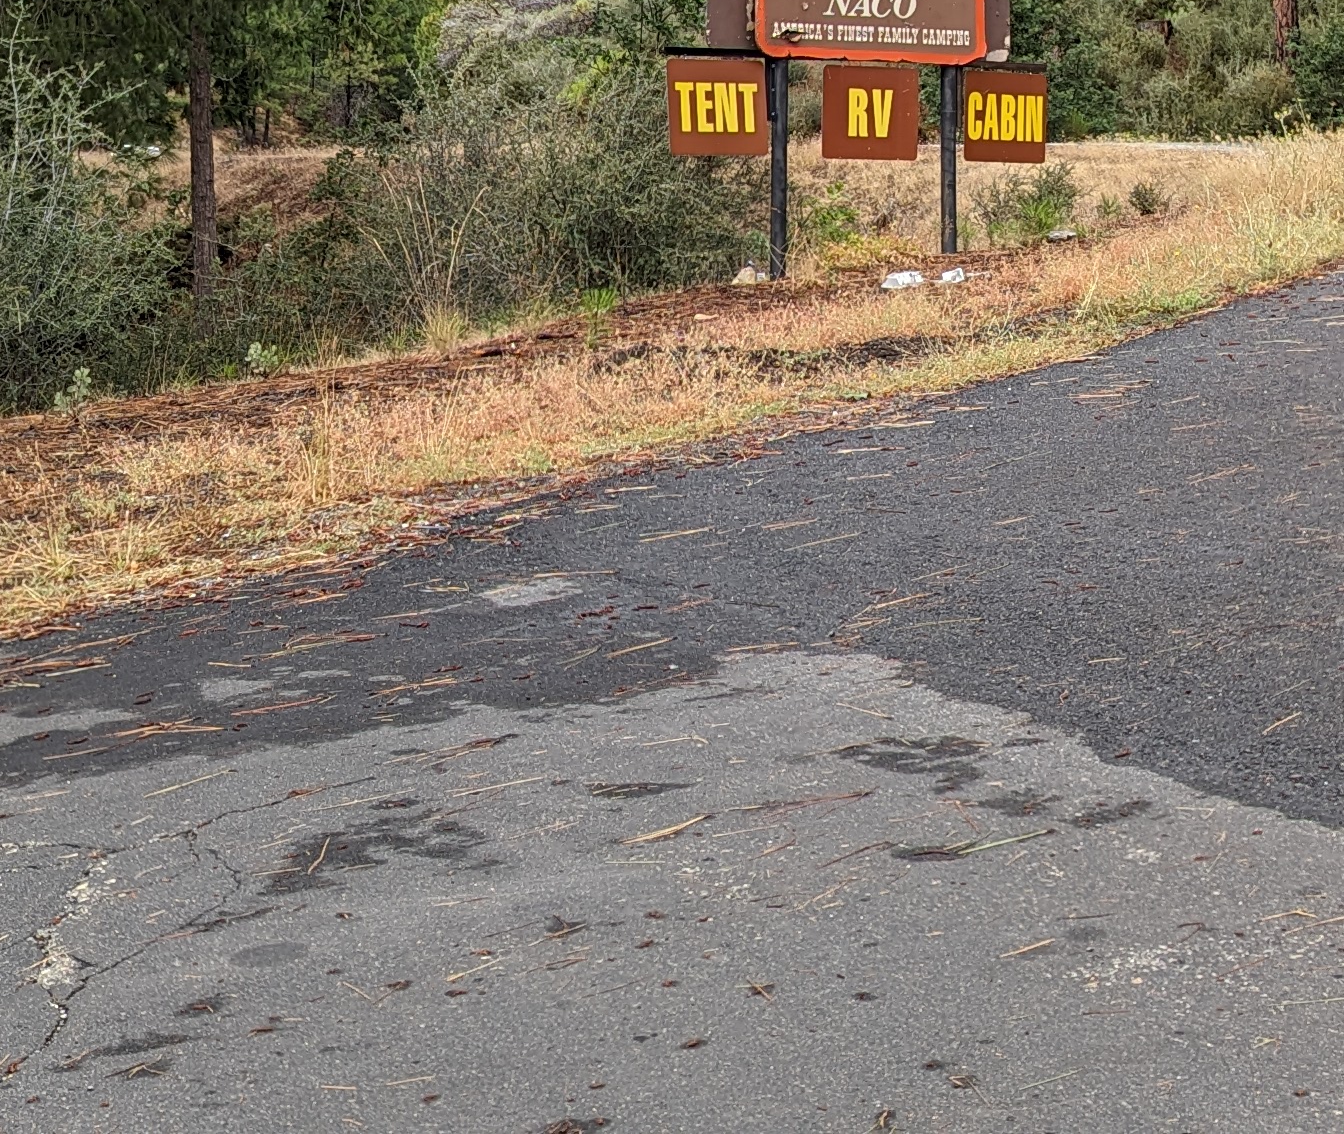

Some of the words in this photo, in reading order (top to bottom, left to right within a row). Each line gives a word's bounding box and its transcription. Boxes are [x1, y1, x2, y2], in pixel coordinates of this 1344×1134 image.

[837, 25, 874, 43] FINEST
[877, 26, 920, 45] FAMILY
[922, 29, 971, 46] CAMPING
[674, 81, 758, 133] TENT
[847, 87, 893, 138] RV
[967, 91, 1044, 143] CABIN
